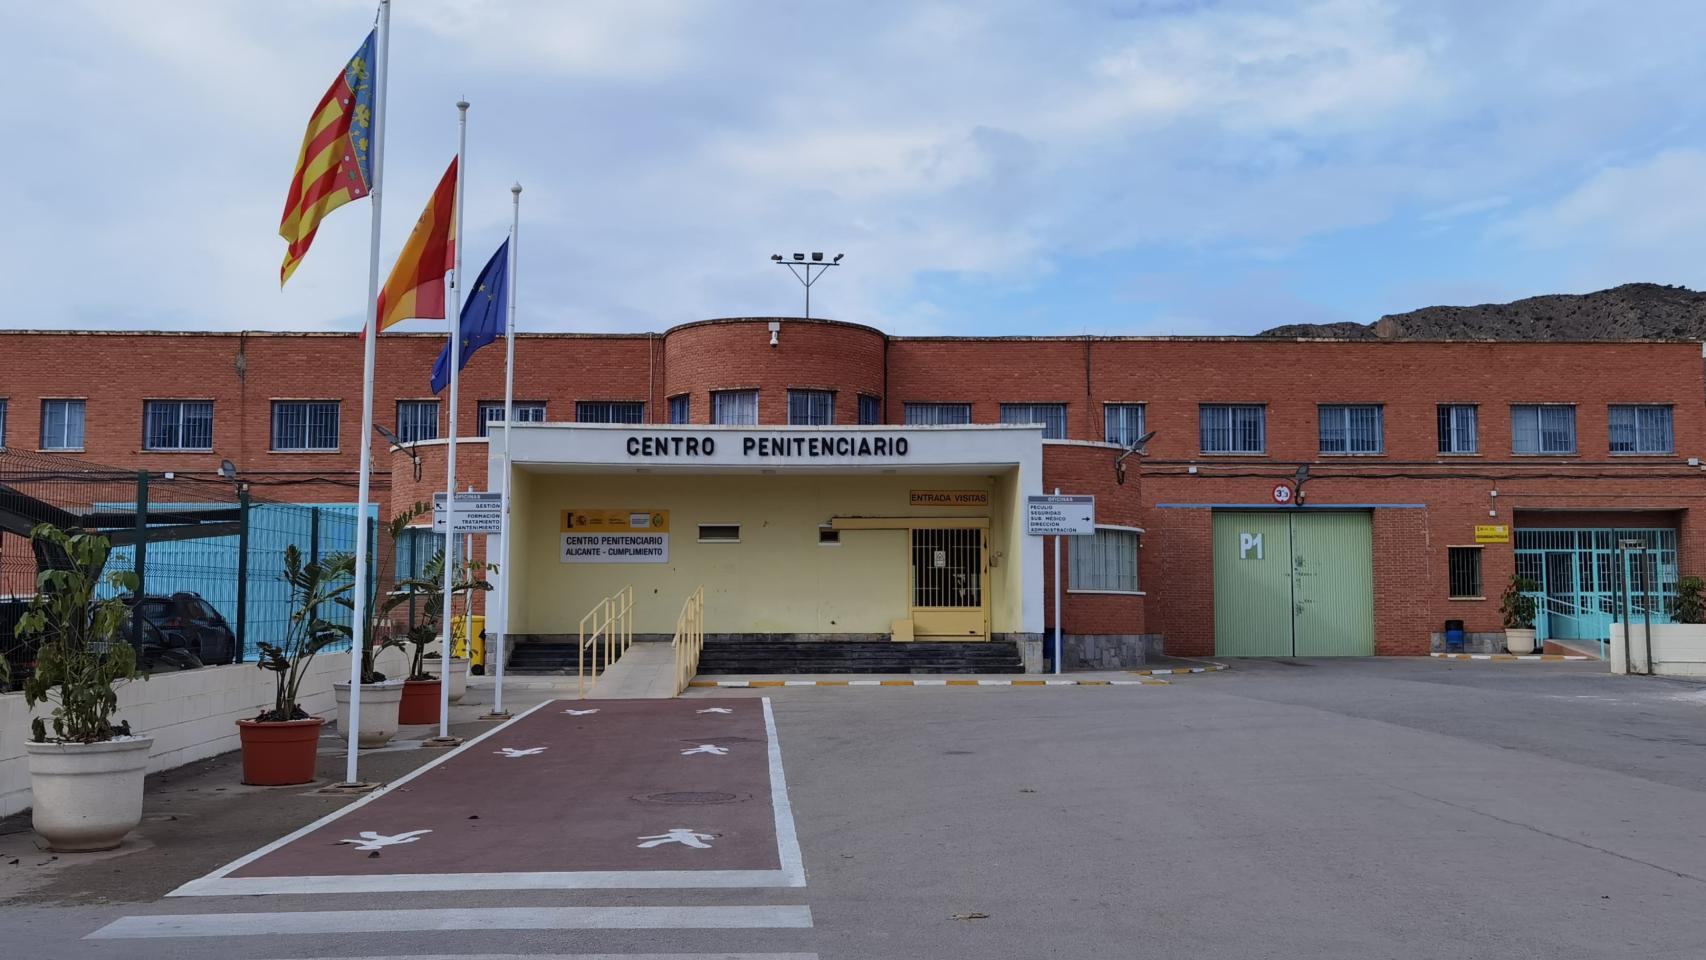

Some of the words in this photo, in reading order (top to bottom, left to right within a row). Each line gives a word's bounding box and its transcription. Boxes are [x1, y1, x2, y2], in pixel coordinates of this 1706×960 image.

[626, 436, 715, 457] CENTRO
[743, 436, 908, 457] PENITENCIARIO
[911, 494, 951, 502] ENTRADA
[954, 494, 986, 502] VISITAS
[566, 536, 599, 545] CENTRO
[601, 536, 663, 545] PENITENCIARIO
[1240, 533, 1263, 559] P1
[565, 548, 601, 556] ALICANTE
[608, 548, 663, 556] CUMPLIMIENTO
